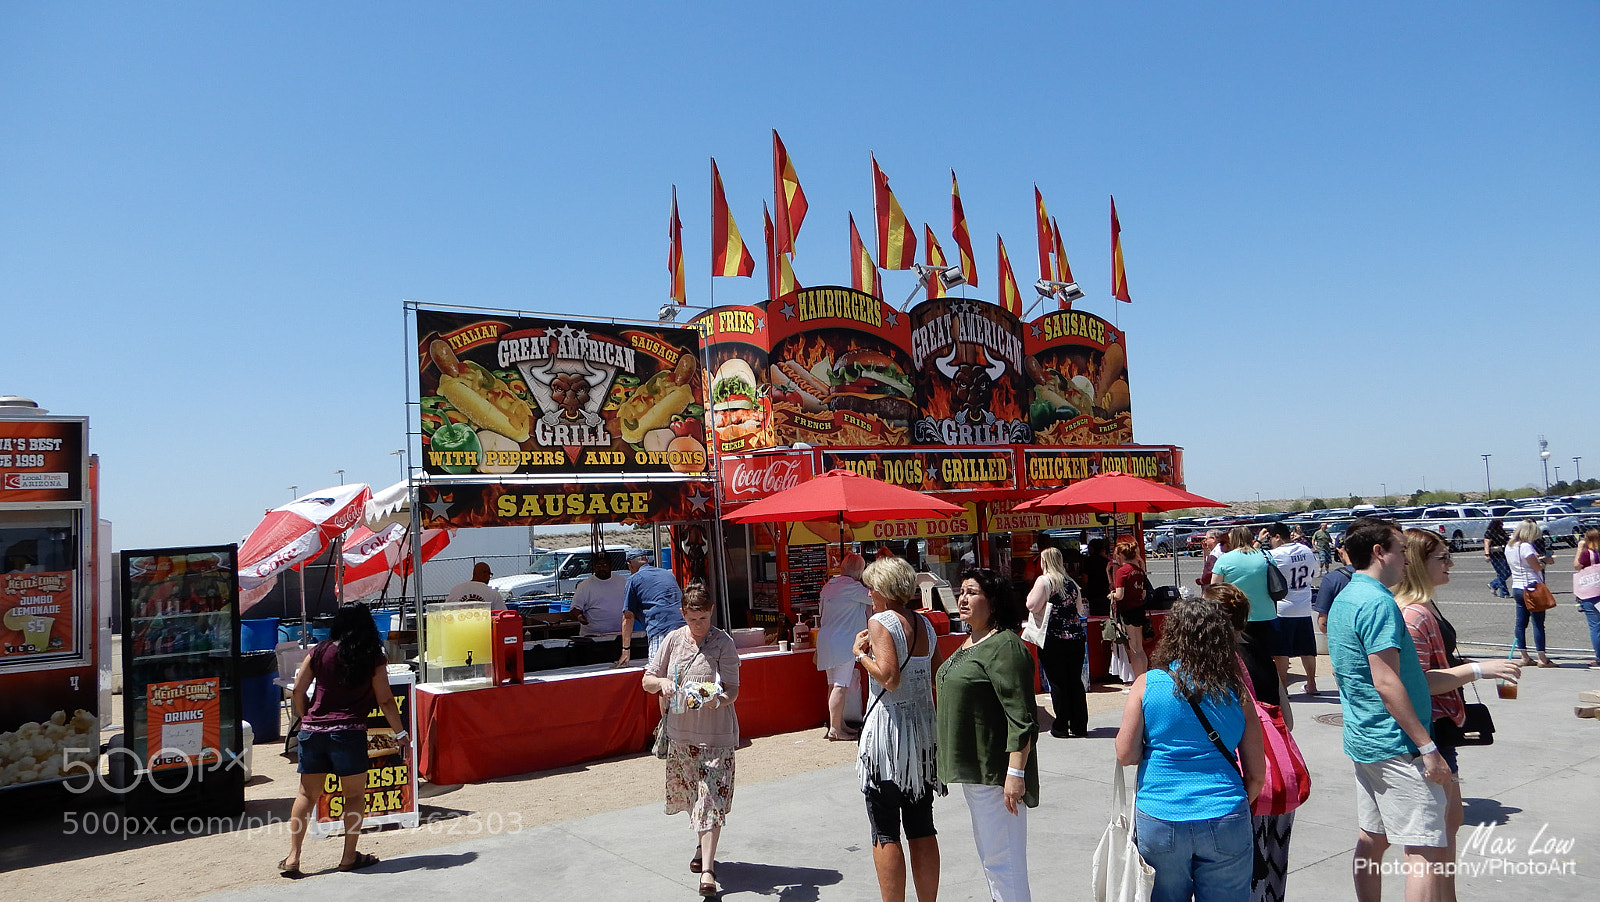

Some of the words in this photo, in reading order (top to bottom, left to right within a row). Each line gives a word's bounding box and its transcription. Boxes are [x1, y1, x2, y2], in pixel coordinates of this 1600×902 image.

[798, 289, 882, 329] HAMBURGERS
[718, 310, 755, 335] FRIES
[1043, 312, 1105, 346] SAUSAGE
[448, 324, 499, 351] ITALIAN
[911, 313, 952, 372] GREAT
[958, 312, 1023, 376] AMERICAN
[498, 336, 550, 368] GREAT
[557, 335, 637, 375] AMERICAN
[631, 334, 680, 365] SAUSAGE
[534, 420, 612, 448] GRILL
[794, 414, 832, 431] FRENCH
[843, 412, 873, 433] FRIES
[942, 418, 1010, 446] GRILL
[1098, 422, 1118, 433] FRIES
[0, 438, 26, 451] A'S
[29, 438, 63, 451] BEST
[15, 454, 45, 467] 1998
[428, 450, 478, 466] WITH
[486, 450, 565, 466] PEPPERS
[584, 450, 627, 466] AND
[635, 450, 706, 466] ONIONS
[1029, 457, 1089, 481] CHICKEN
[1132, 456, 1158, 477] DOGS
[732, 460, 801, 495] Coca-Cola
[844, 460, 877, 479] HOT
[882, 459, 924, 485] DOGS
[941, 458, 1008, 483] GRILLED
[498, 491, 650, 517] SAUSAGE
[873, 521, 918, 538] CORN
[925, 518, 969, 535] DOGS
[995, 514, 1041, 530] BASKET
[360, 531, 392, 556] Coke
[256, 548, 298, 578] Coke
[8, 577, 38, 589] KETTLE
[38, 576, 61, 588] CORN
[1289, 566, 1309, 589] 12
[12, 605, 61, 616] LEMONADE
[20, 595, 53, 606] JUMBO
[26, 620, 46, 633] $5
[69, 676, 79, 691] 4
[154, 687, 185, 700] KETTLE
[185, 685, 210, 695] CORN
[164, 709, 204, 723] DRINKS
